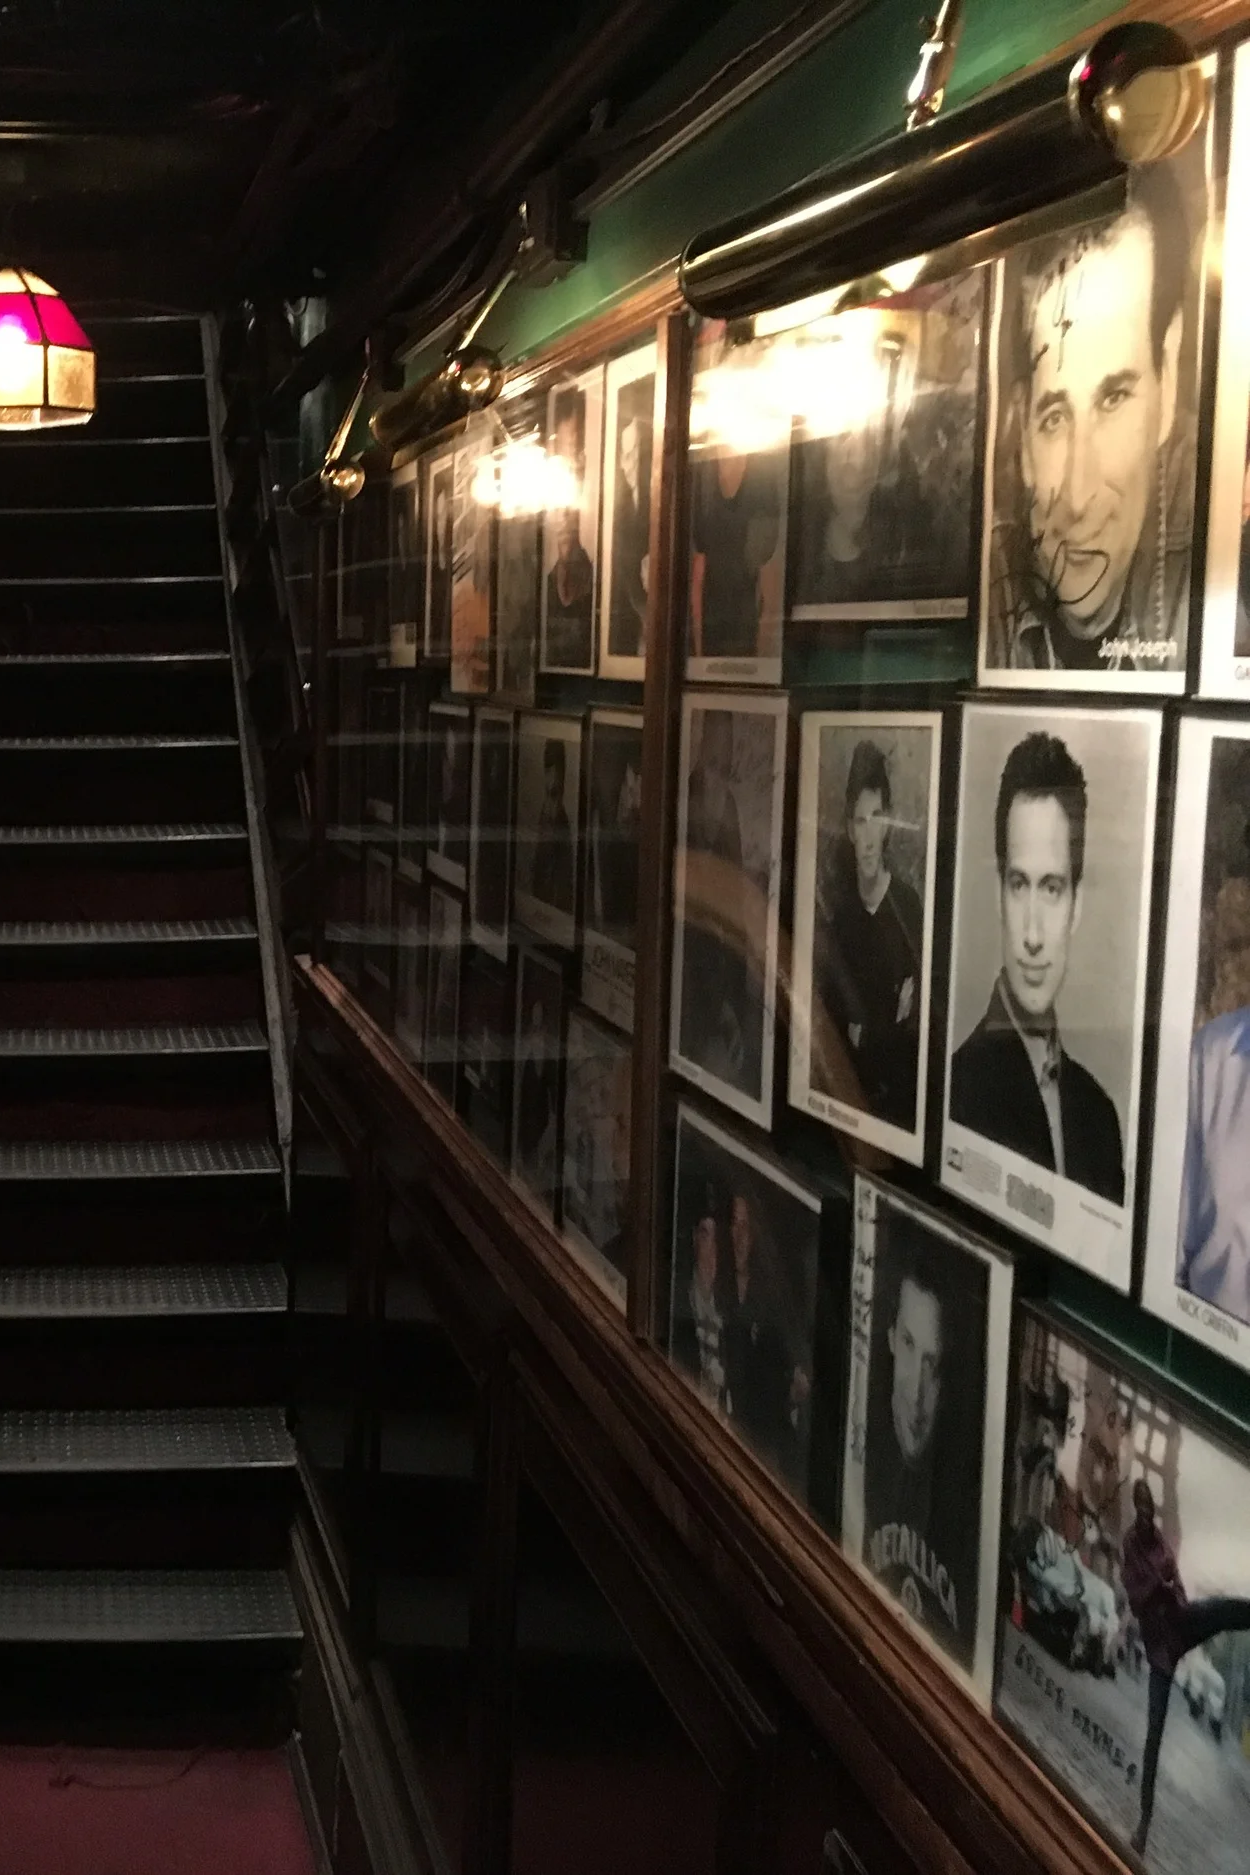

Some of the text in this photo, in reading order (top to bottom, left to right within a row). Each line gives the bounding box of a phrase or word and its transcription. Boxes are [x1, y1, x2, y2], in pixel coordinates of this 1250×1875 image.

[1098, 636, 1177, 664] John Joseph
[871, 1522, 958, 1633] METALLICA
